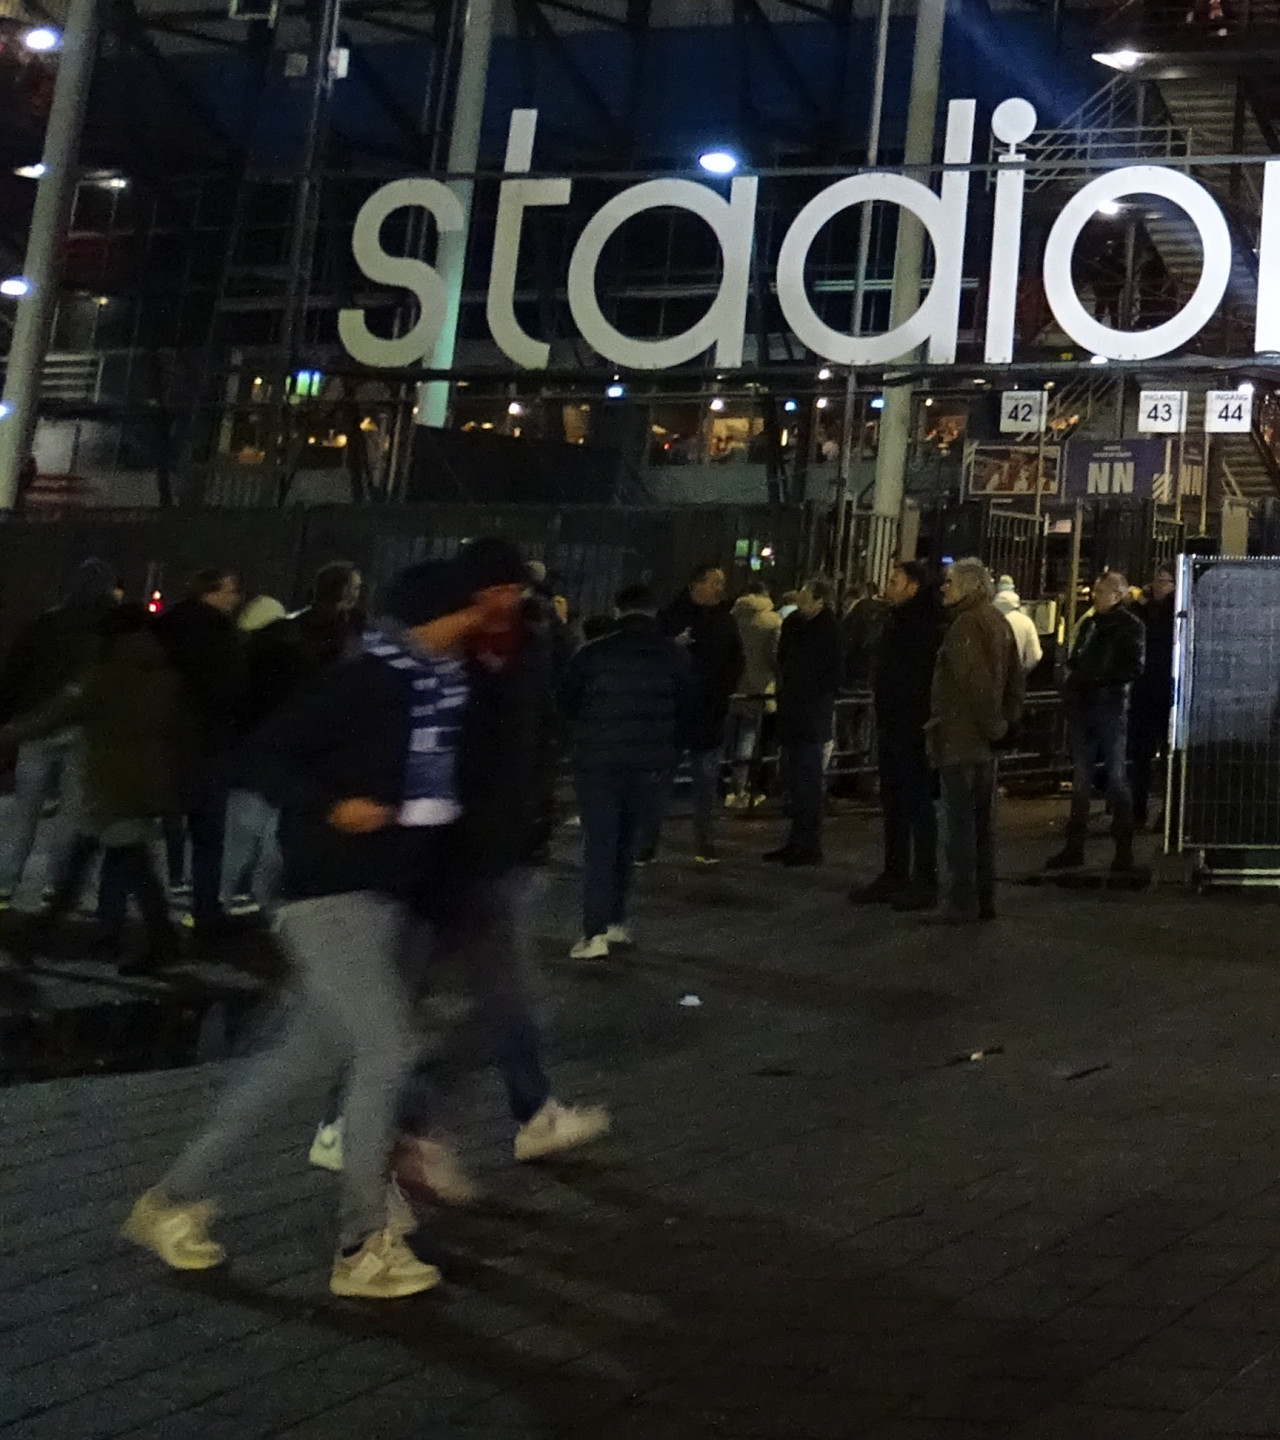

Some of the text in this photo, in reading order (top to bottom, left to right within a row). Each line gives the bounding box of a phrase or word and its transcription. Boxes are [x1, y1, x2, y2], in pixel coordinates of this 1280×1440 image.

[1214, 393, 1249, 401] INGANG
[1008, 403, 1033, 422] 42
[1146, 403, 1172, 422] 43
[1217, 403, 1244, 422] 44
[1087, 462, 1135, 494] NN
